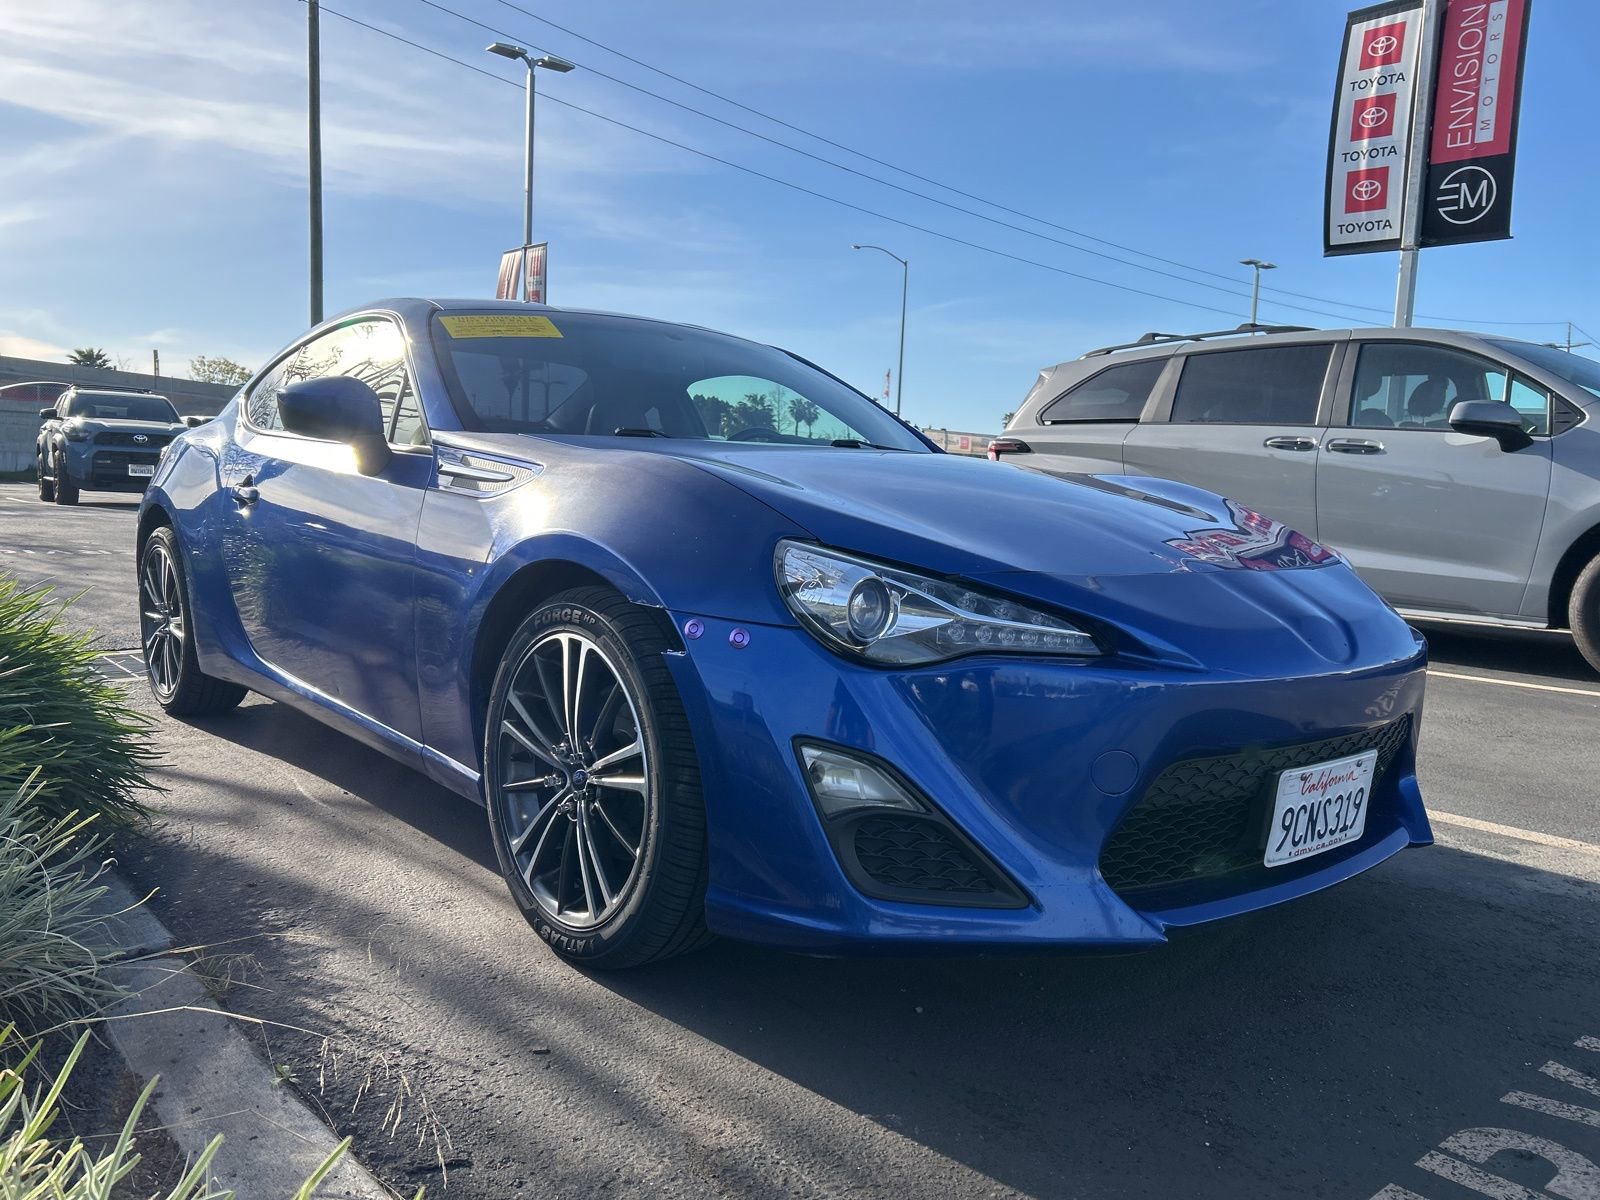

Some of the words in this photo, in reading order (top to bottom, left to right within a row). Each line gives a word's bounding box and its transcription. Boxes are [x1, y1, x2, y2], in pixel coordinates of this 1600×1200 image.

[1350, 72, 1405, 91] TOYOTA
[1447, 4, 1486, 148] ENVISION
[1480, 13, 1503, 131] MOTORS
[1342, 145, 1397, 162] TOYOTA
[1337, 219, 1392, 235] TOYOTA
[534, 607, 582, 629] FORCE
[583, 614, 596, 624] HP
[1301, 768, 1359, 797] California
[1275, 786, 1365, 853] 9CNS319
[1294, 836, 1343, 857] dmv.ca.gov
[540, 925, 586, 953] ATLAS
